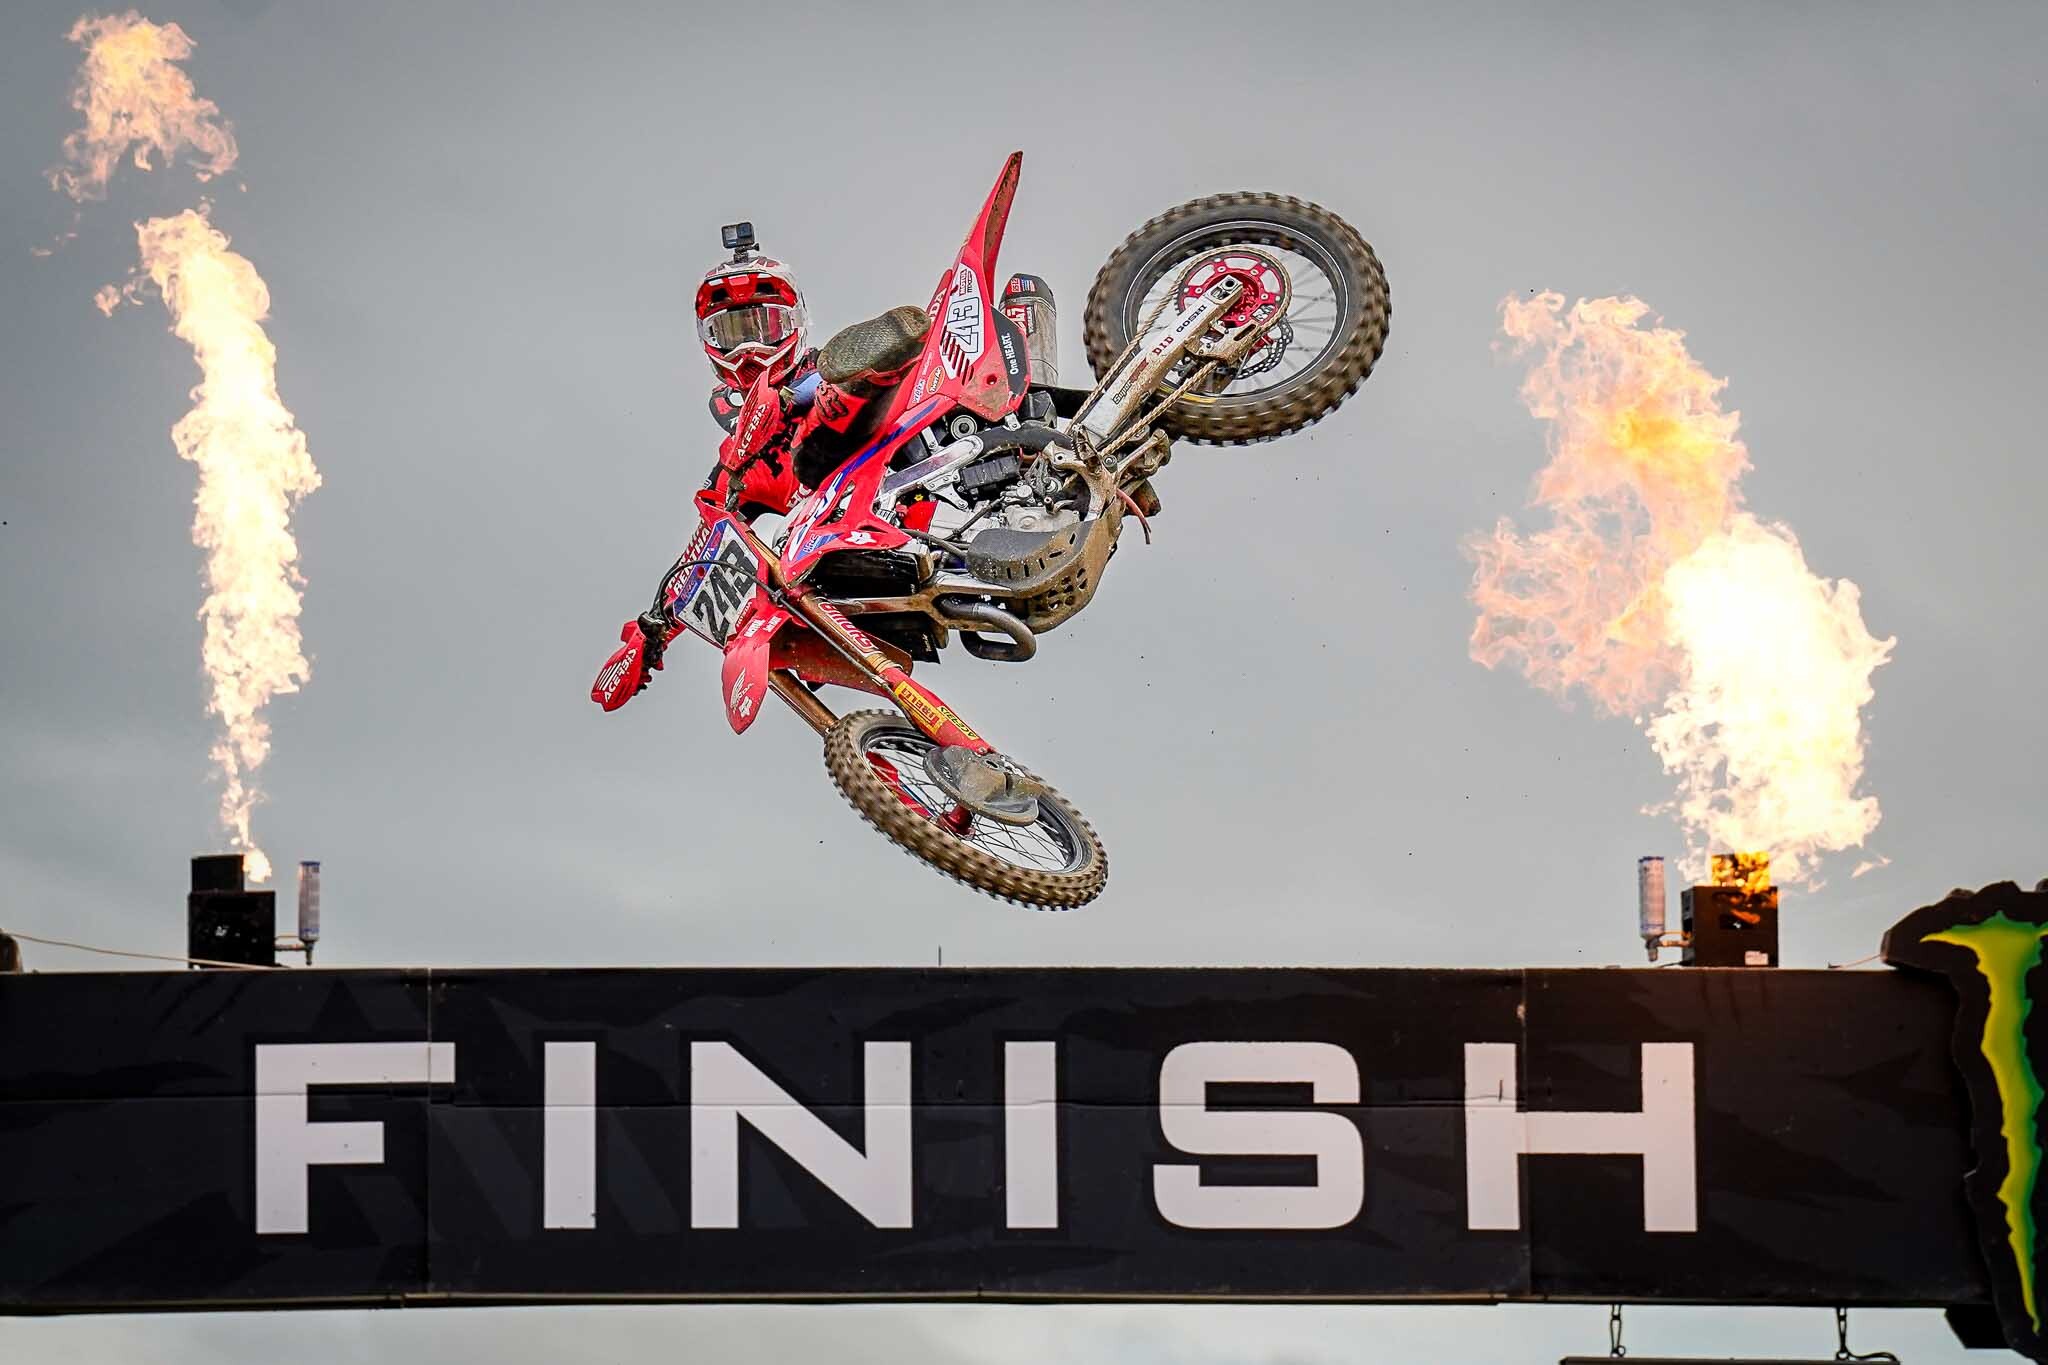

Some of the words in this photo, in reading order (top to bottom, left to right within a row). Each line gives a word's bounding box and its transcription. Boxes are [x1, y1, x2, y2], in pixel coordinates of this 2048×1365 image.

[942, 297, 979, 355] 243
[1176, 304, 1207, 333] GOSHI
[1009, 359, 1018, 375] One
[737, 403, 767, 460] ACERBIS
[692, 540, 757, 646] 243
[604, 648, 637, 703] ACERBIS
[898, 688, 940, 727] PIRELLI
[255, 1040, 1698, 1235] FINISH
